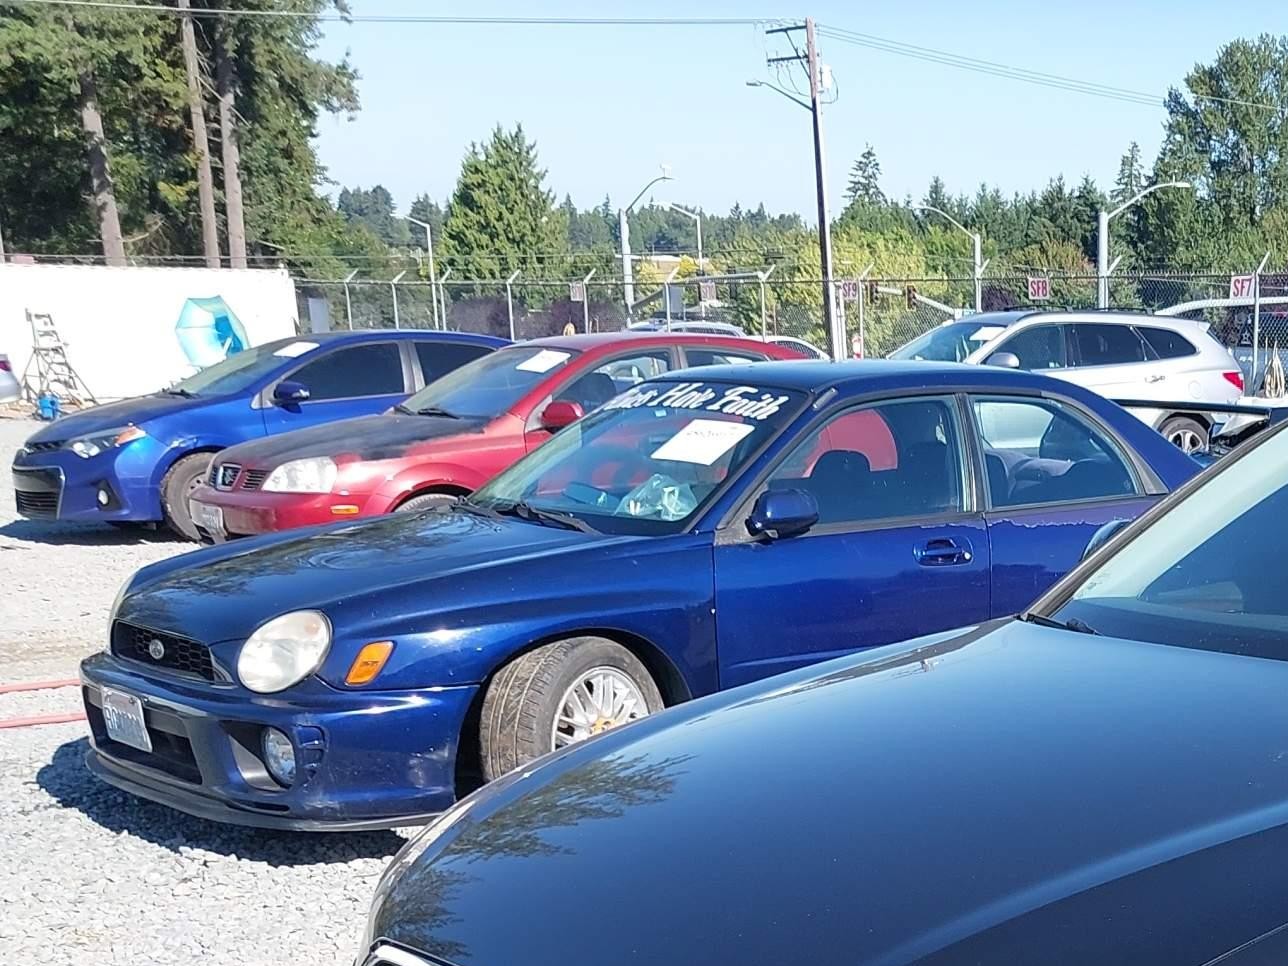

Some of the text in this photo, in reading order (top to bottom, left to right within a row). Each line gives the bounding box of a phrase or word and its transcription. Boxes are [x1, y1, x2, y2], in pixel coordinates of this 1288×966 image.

[842, 282, 857, 297] SF9
[1030, 280, 1047, 297] SF8
[1232, 278, 1252, 297] SF7
[647, 382, 715, 409] Have
[705, 386, 789, 420] Faith
